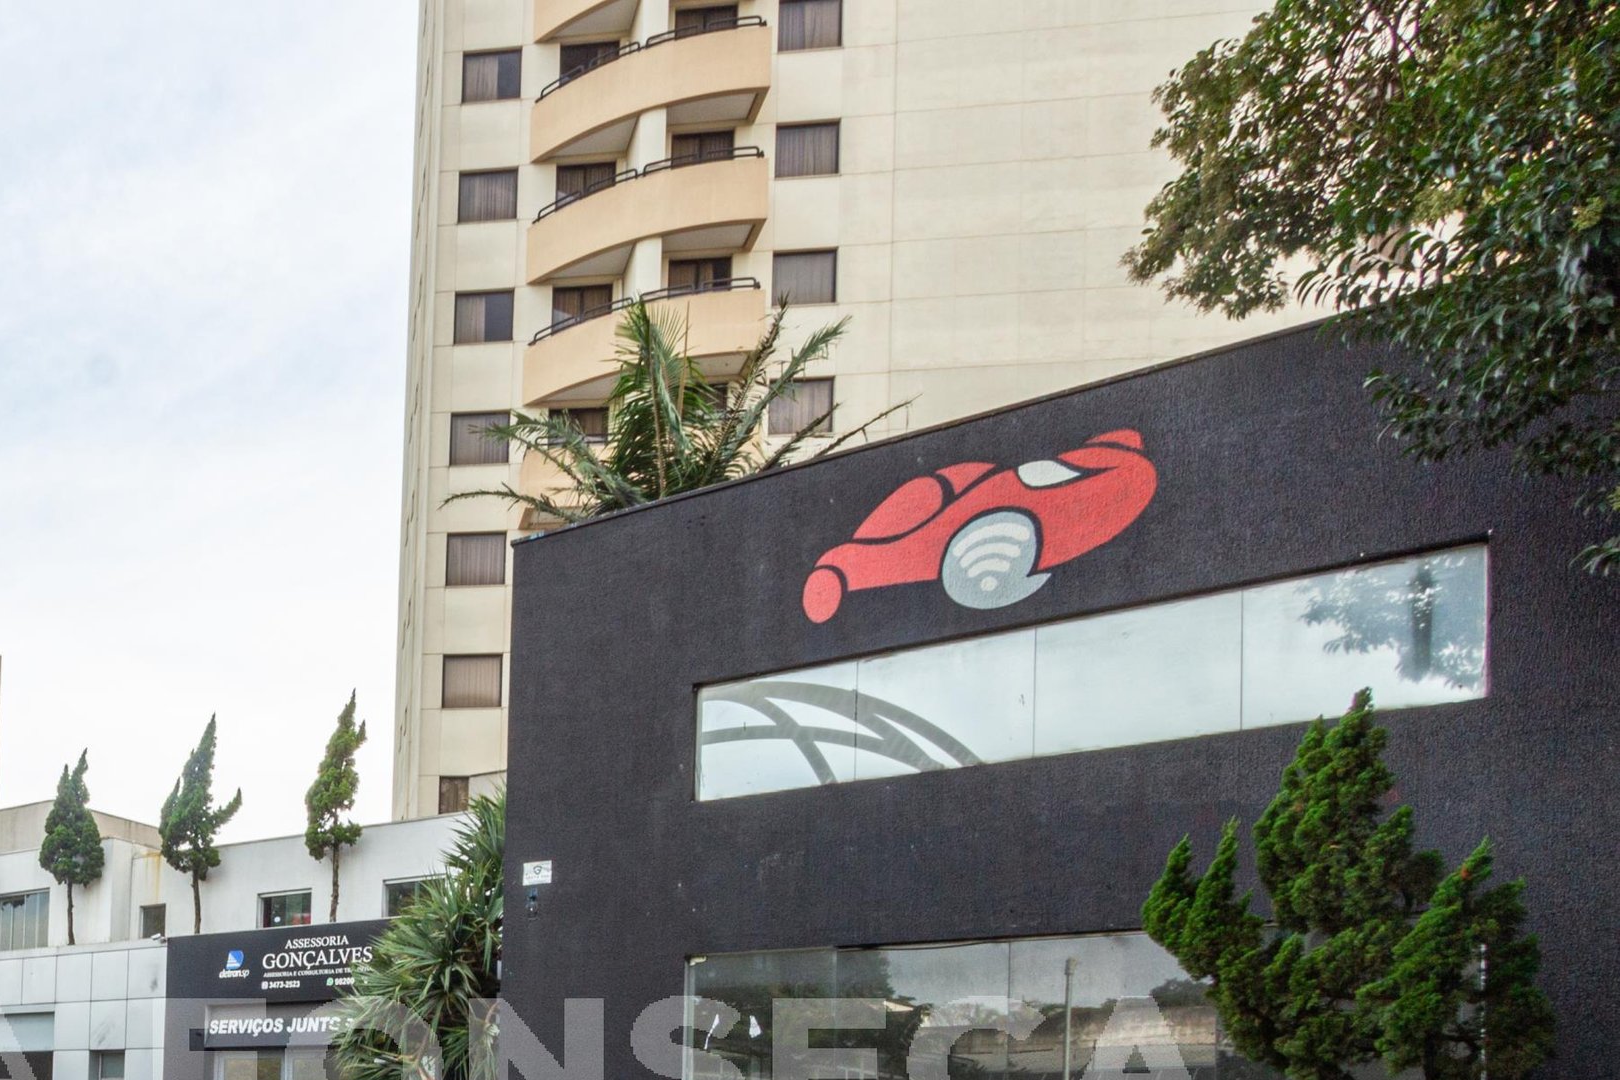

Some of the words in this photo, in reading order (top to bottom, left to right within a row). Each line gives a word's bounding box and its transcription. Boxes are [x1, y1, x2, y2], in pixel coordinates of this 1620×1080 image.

[285, 935, 349, 950] ASSESSORIA
[262, 946, 373, 970] GONÇALVES
[209, 1018, 284, 1037] SERVIÇOS
